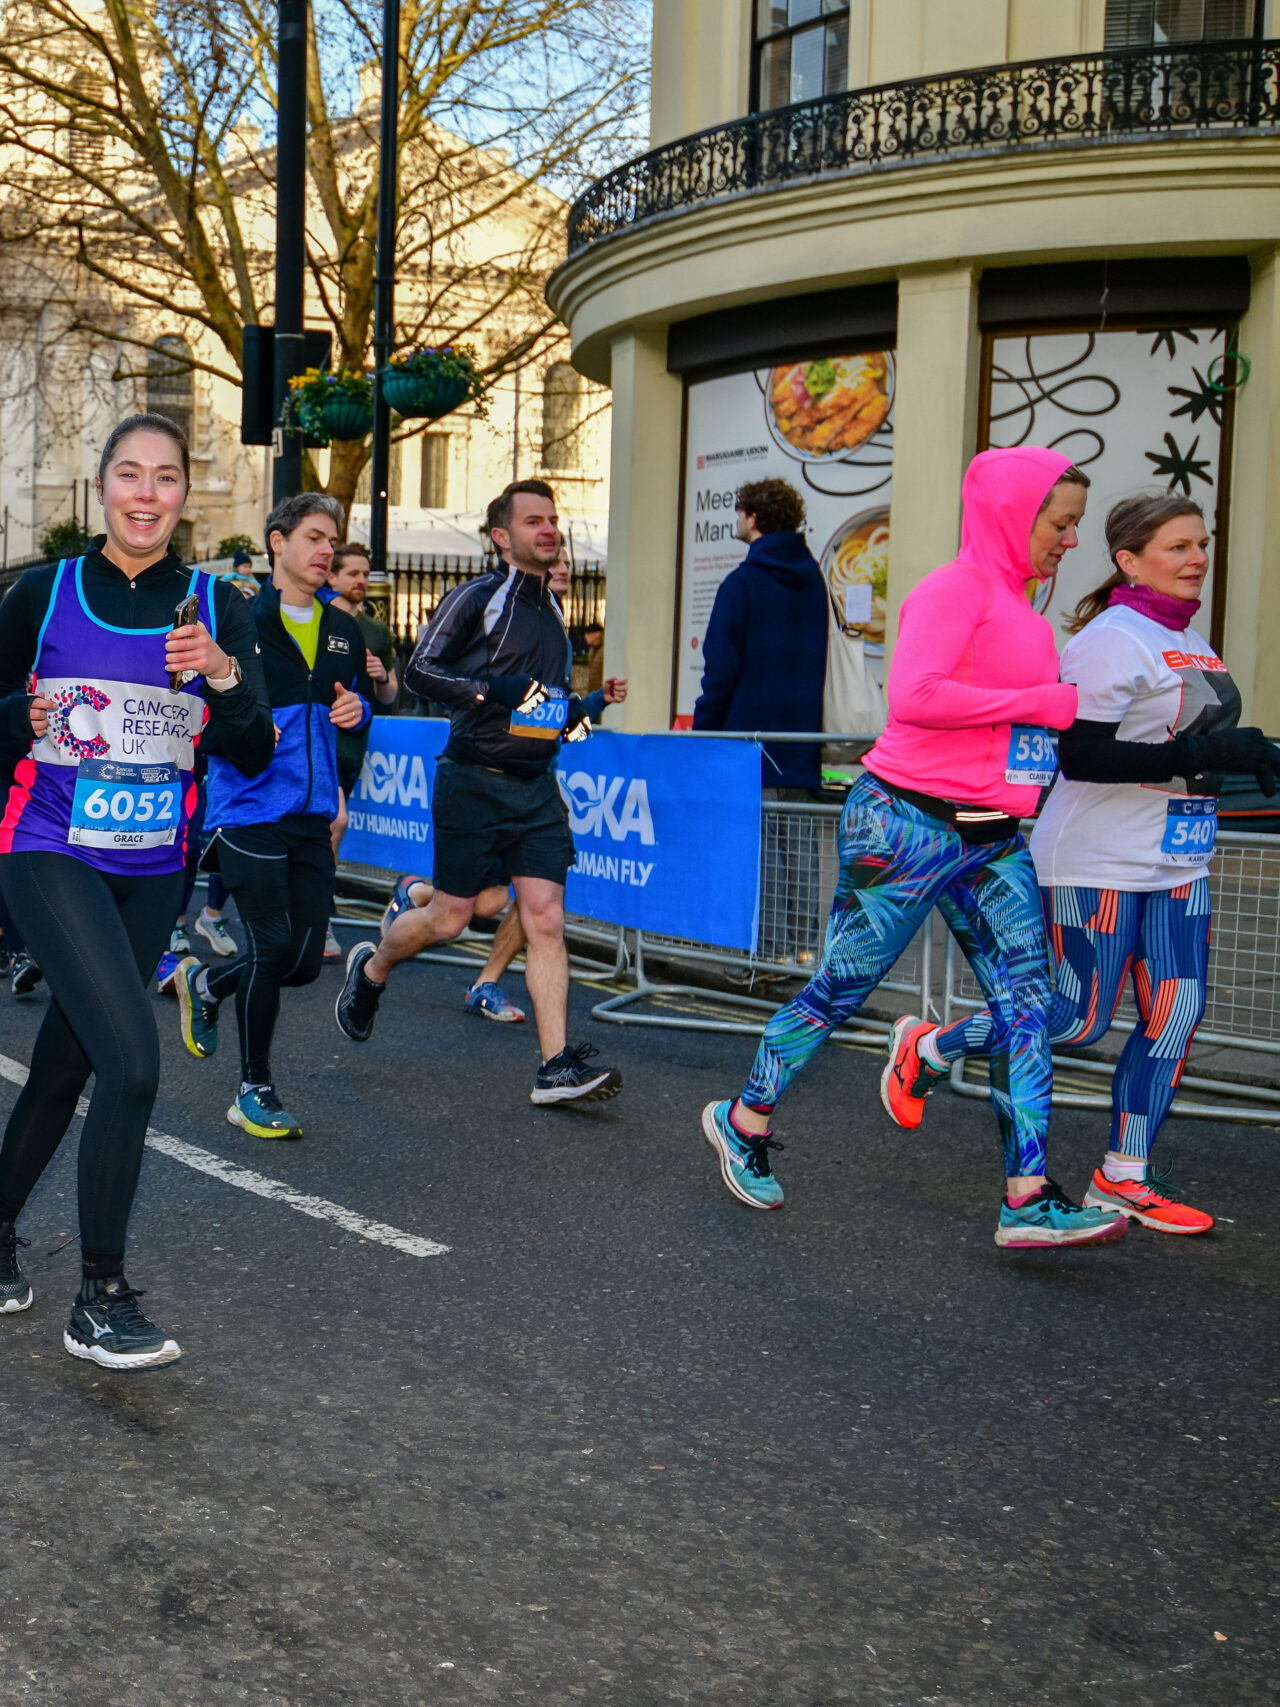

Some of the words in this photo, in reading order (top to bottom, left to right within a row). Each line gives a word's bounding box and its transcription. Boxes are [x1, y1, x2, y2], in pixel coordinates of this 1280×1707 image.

[123, 698, 189, 721] CANCER
[526, 703, 565, 723] 670
[122, 738, 146, 755] UK
[84, 788, 174, 822] 6052
[347, 810, 365, 831] FLY
[366, 813, 408, 840] HUMAN
[409, 820, 429, 843] FLY
[114, 834, 144, 843] GRACE
[568, 850, 619, 882] UMAN
[620, 859, 654, 887] FLY
